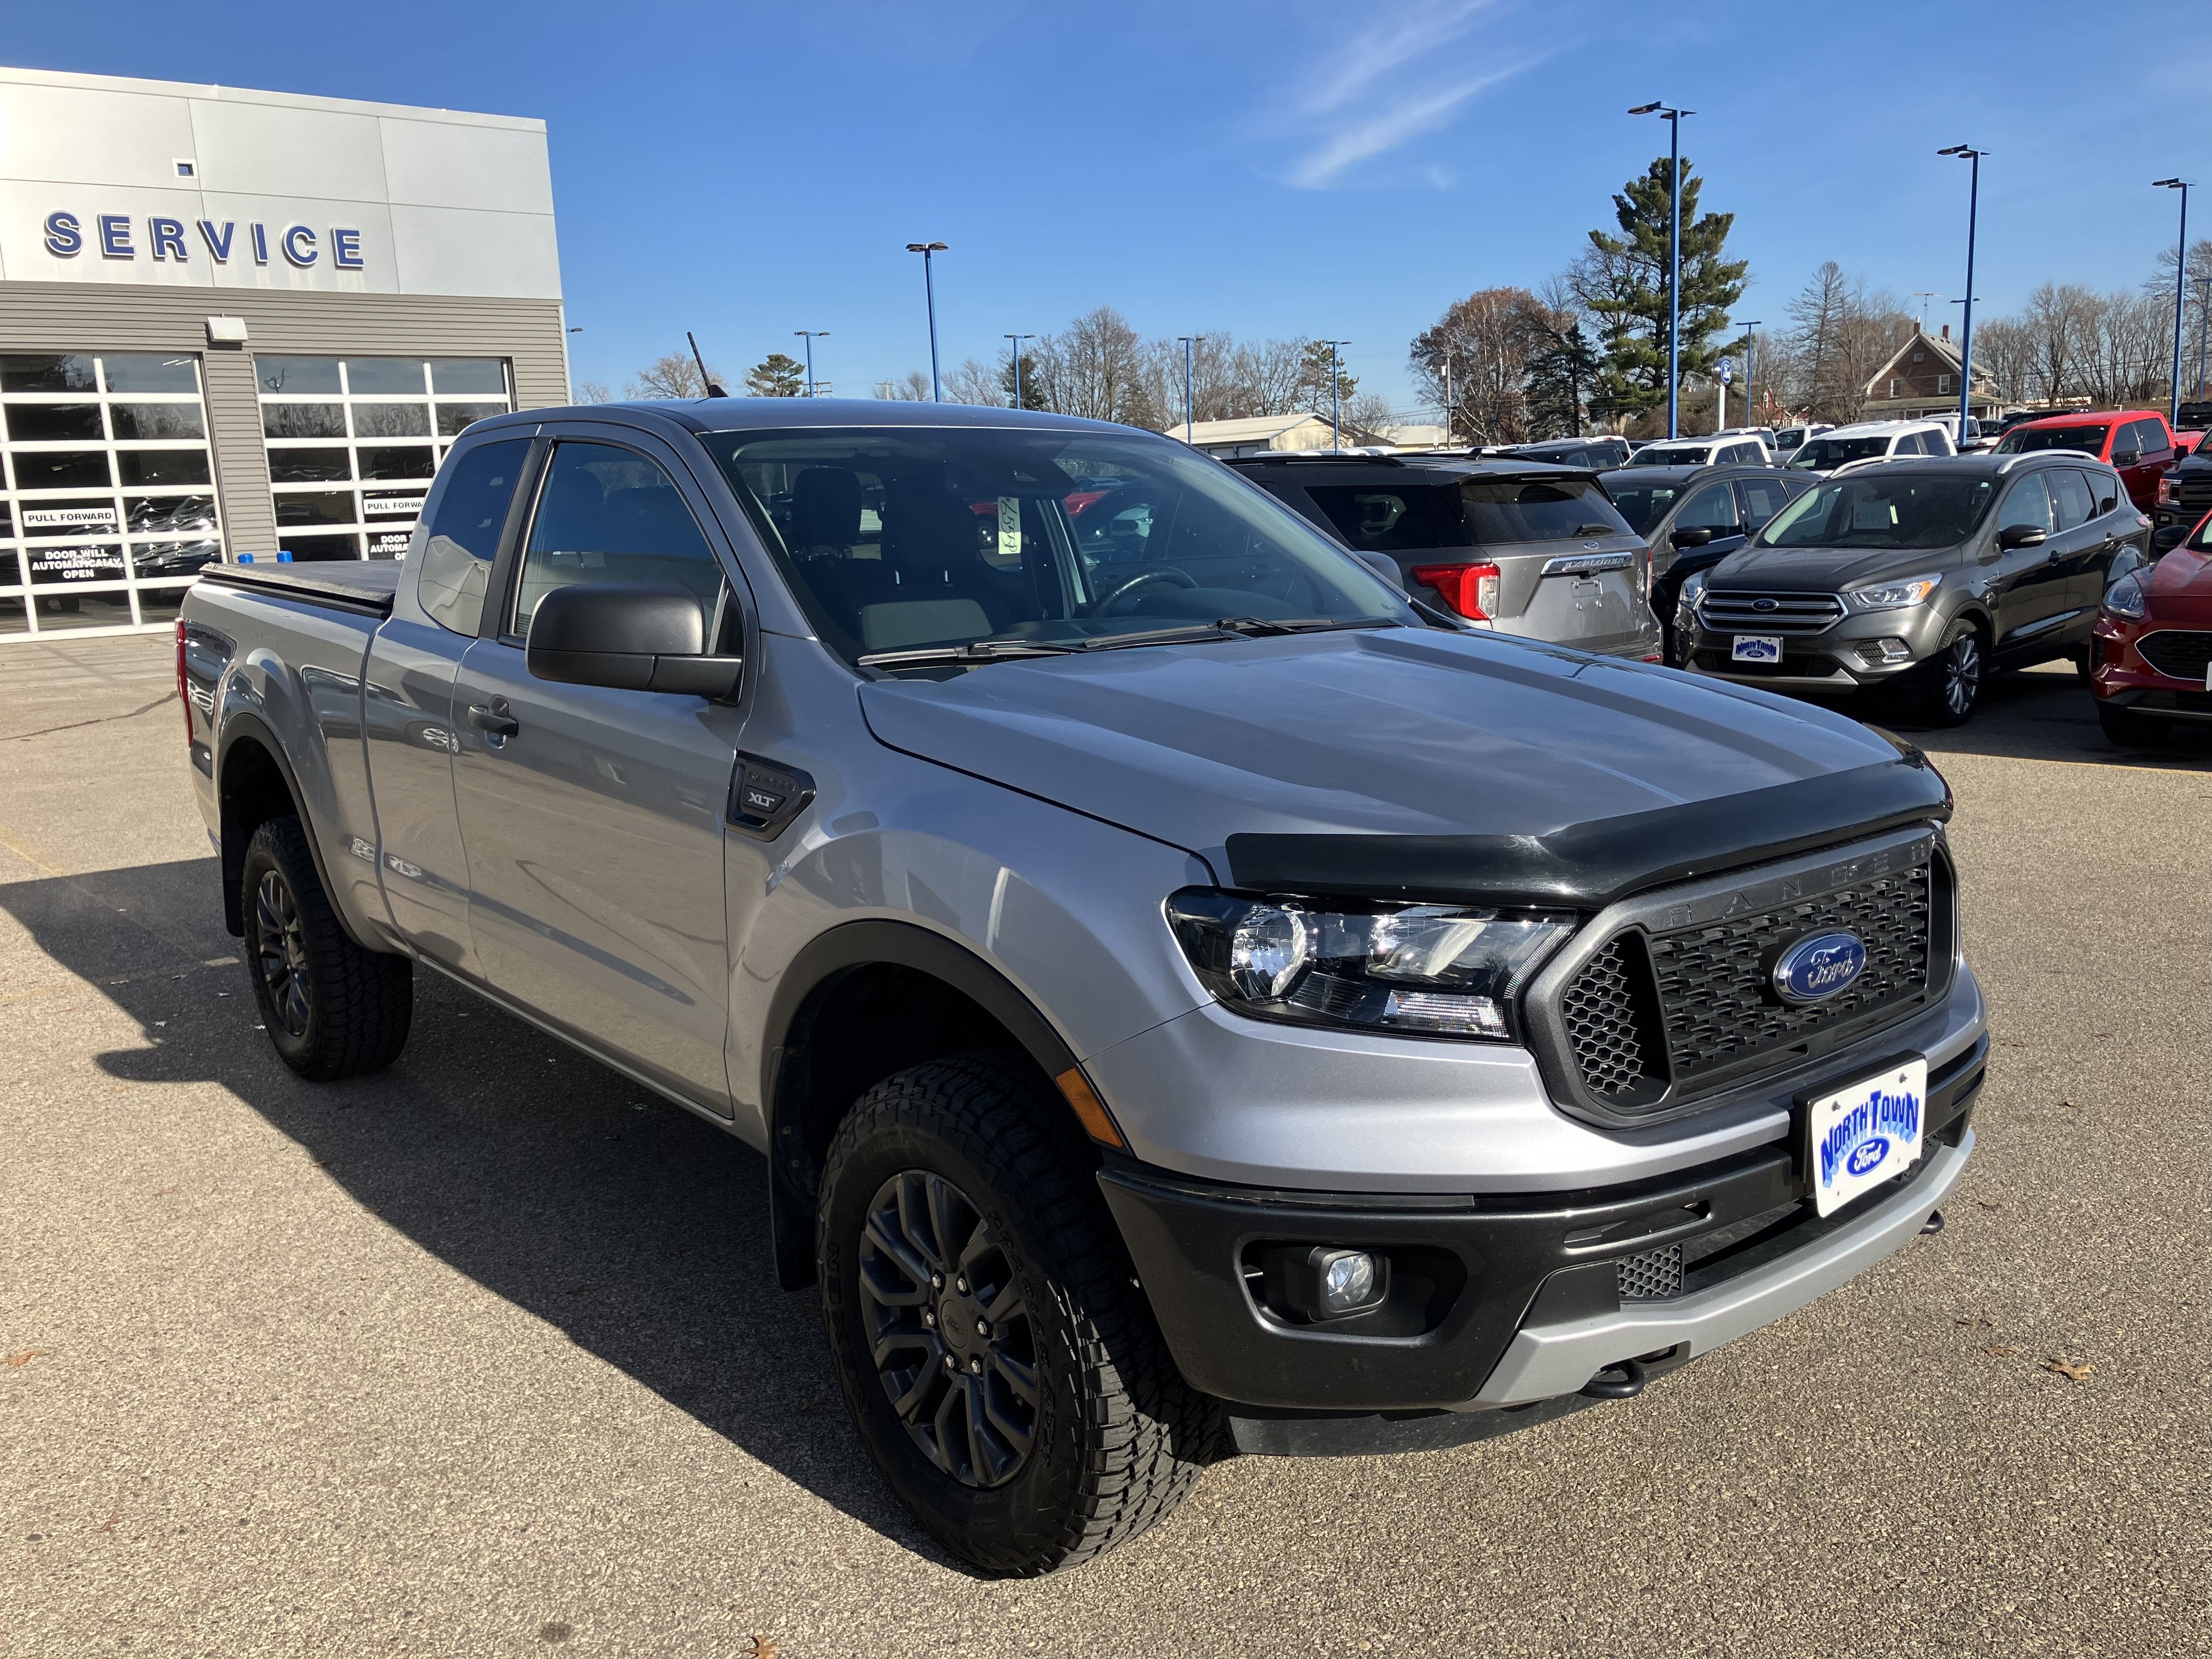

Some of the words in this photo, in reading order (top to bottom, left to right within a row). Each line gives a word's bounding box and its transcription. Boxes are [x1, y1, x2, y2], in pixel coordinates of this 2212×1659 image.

[44, 210, 365, 269] SERVICE
[60, 512, 112, 521] FORWARD
[381, 534, 407, 544] DOOR
[44, 550, 77, 560] DOOR
[80, 549, 109, 558] WILL
[32, 557, 121, 571] AUTOMATICALLY
[1565, 557, 1624, 568] EXPLORER
[63, 569, 94, 579] OPEN
[748, 792, 775, 808] XLT
[1668, 843, 1926, 927] RANGER
[1807, 945, 1854, 989] Ford
[1854, 1142, 1882, 1172] Ford
